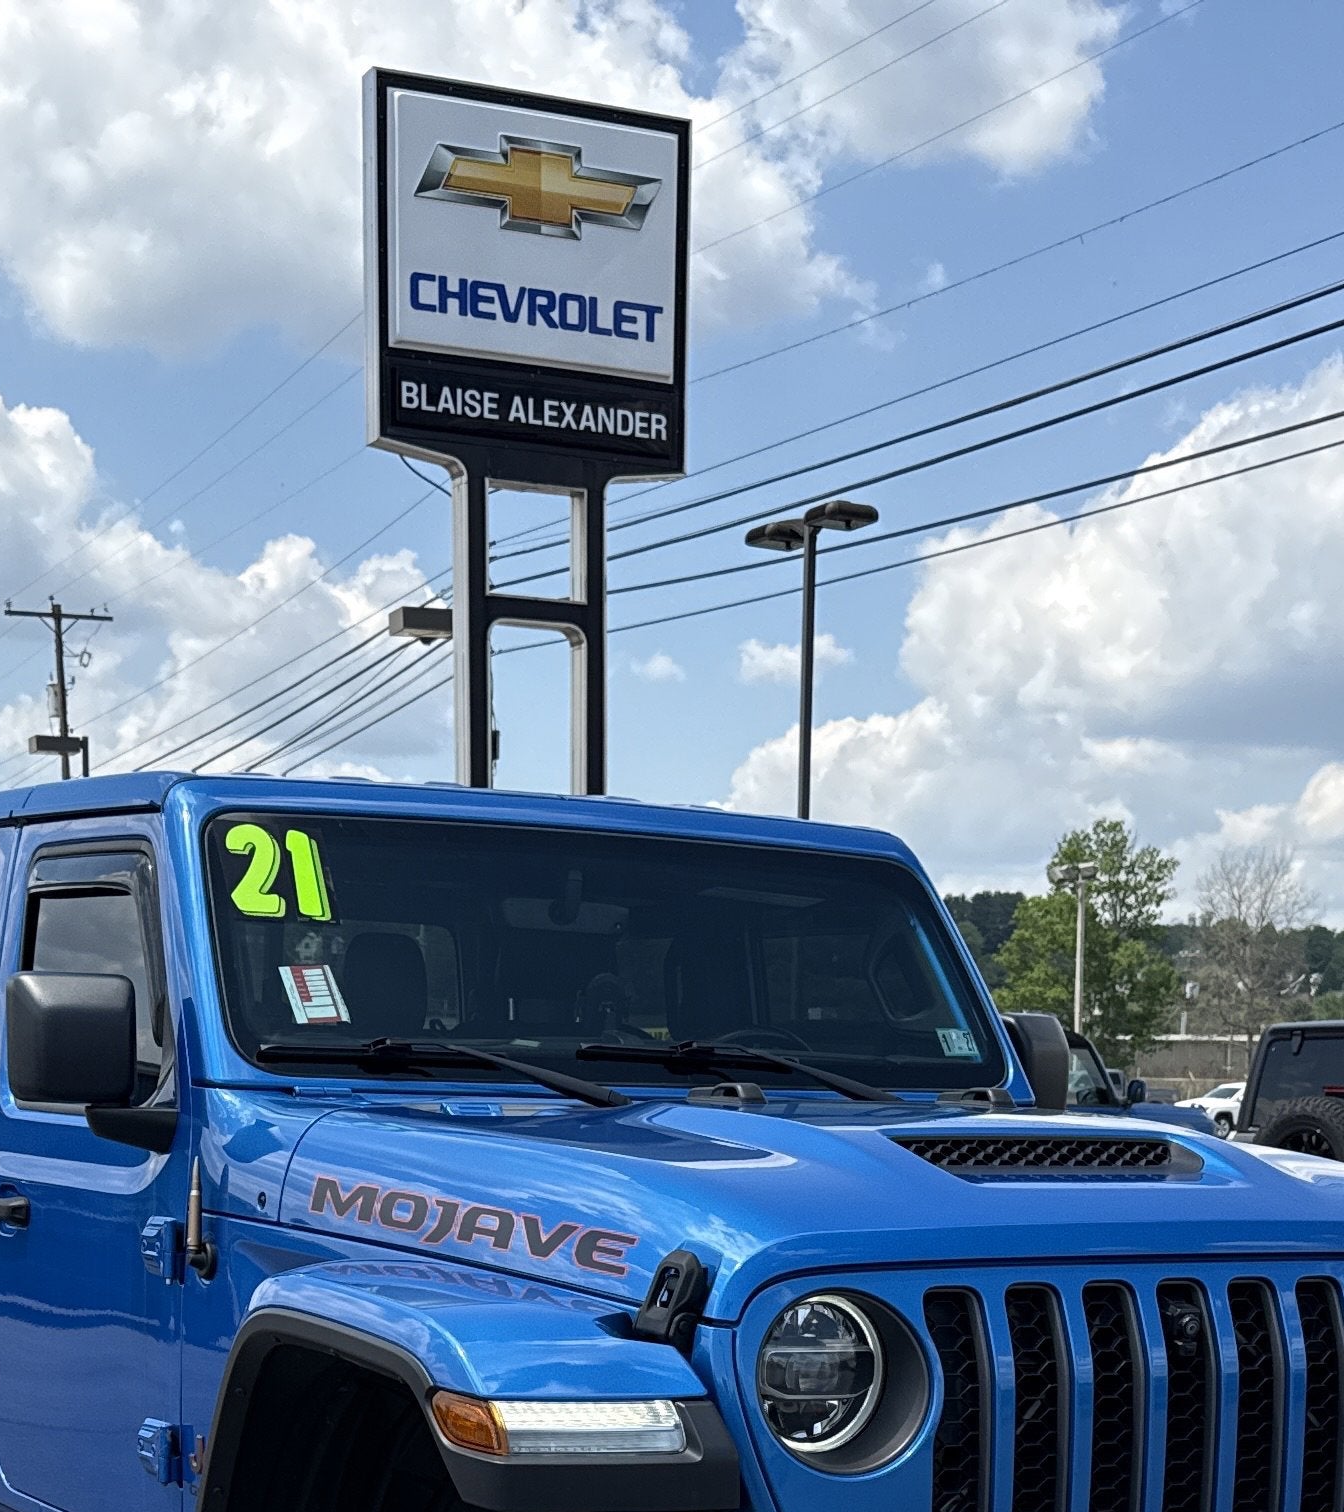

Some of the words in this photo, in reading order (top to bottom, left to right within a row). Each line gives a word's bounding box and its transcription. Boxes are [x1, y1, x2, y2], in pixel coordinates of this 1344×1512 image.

[410, 271, 664, 342] CHEVROLET
[401, 380, 500, 421] BLAISE
[508, 395, 668, 441] ALEXANDER
[225, 823, 332, 921] 21
[308, 1175, 640, 1278] MOJAVE
